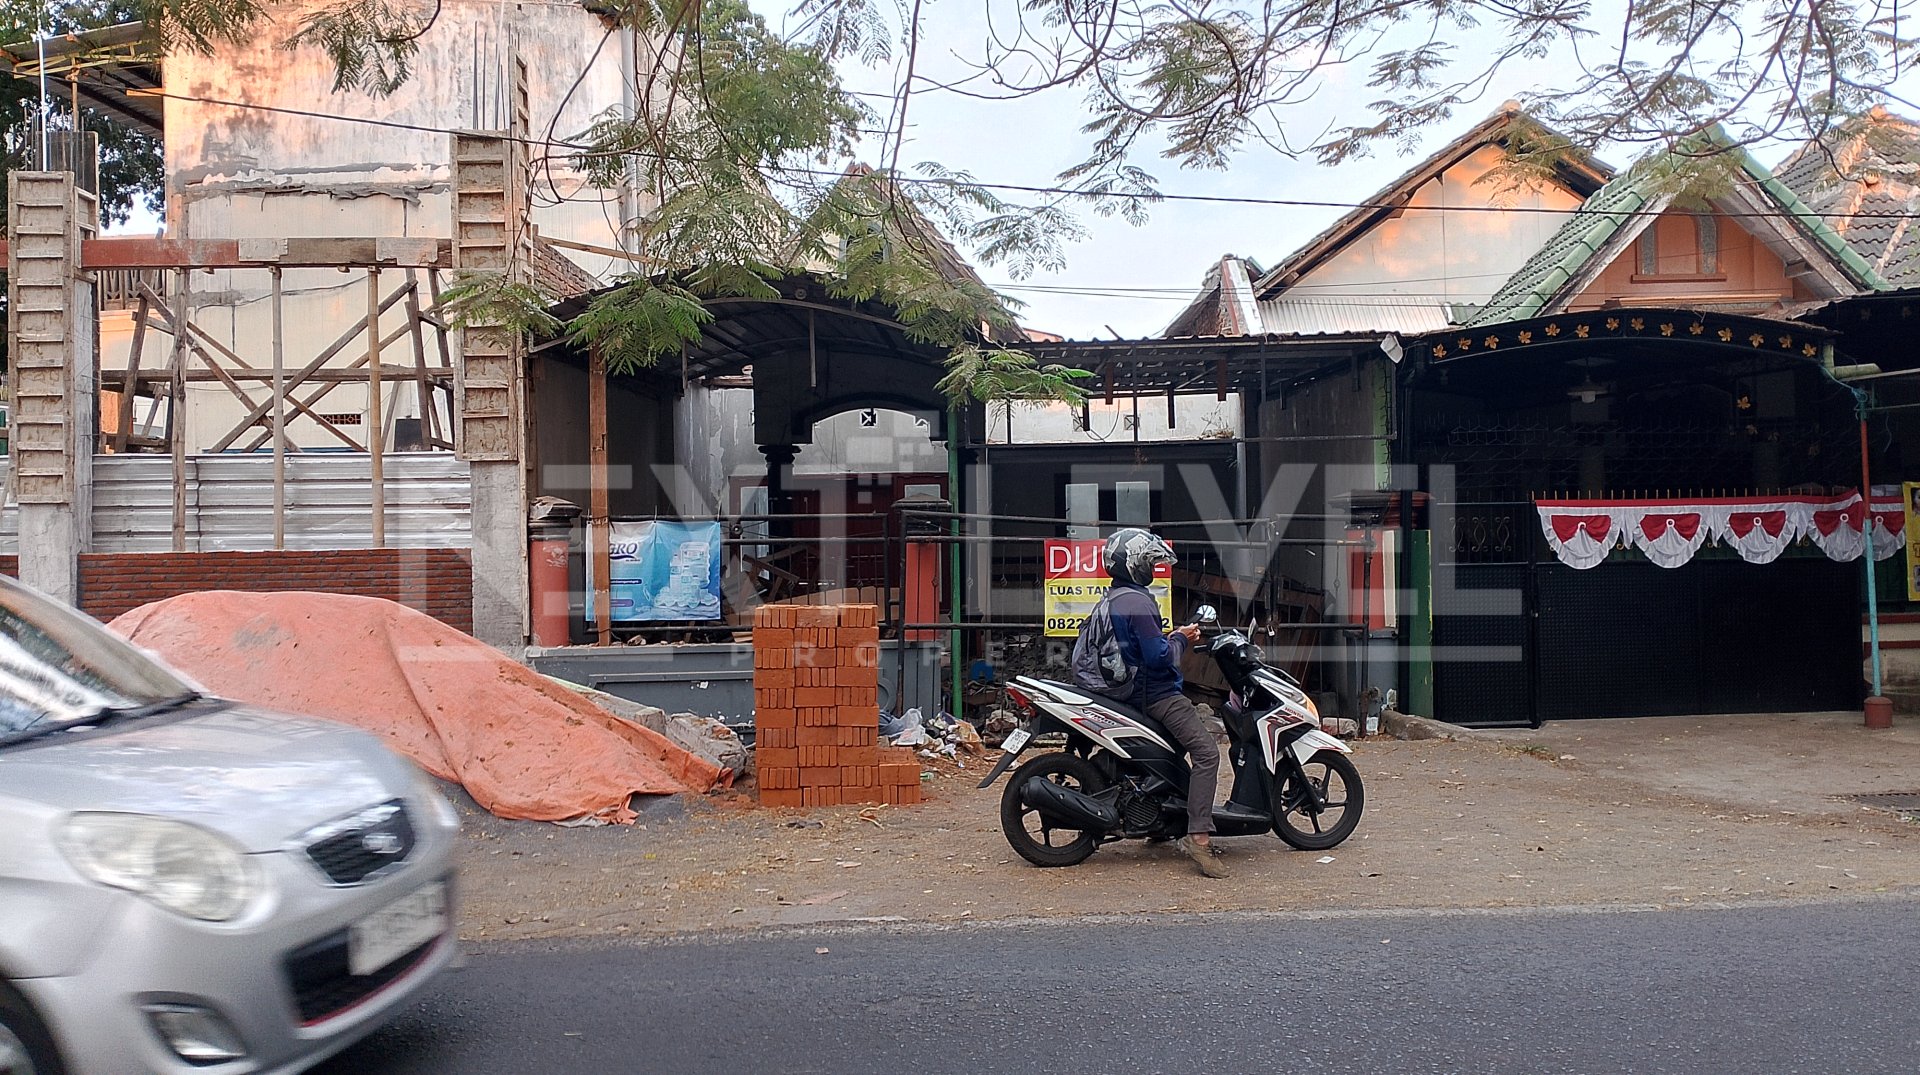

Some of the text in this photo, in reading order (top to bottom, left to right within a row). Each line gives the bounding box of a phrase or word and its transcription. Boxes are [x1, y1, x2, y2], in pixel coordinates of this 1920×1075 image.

[609, 542, 639, 556] GRO
[1049, 585, 1112, 596] LUAS TAN
